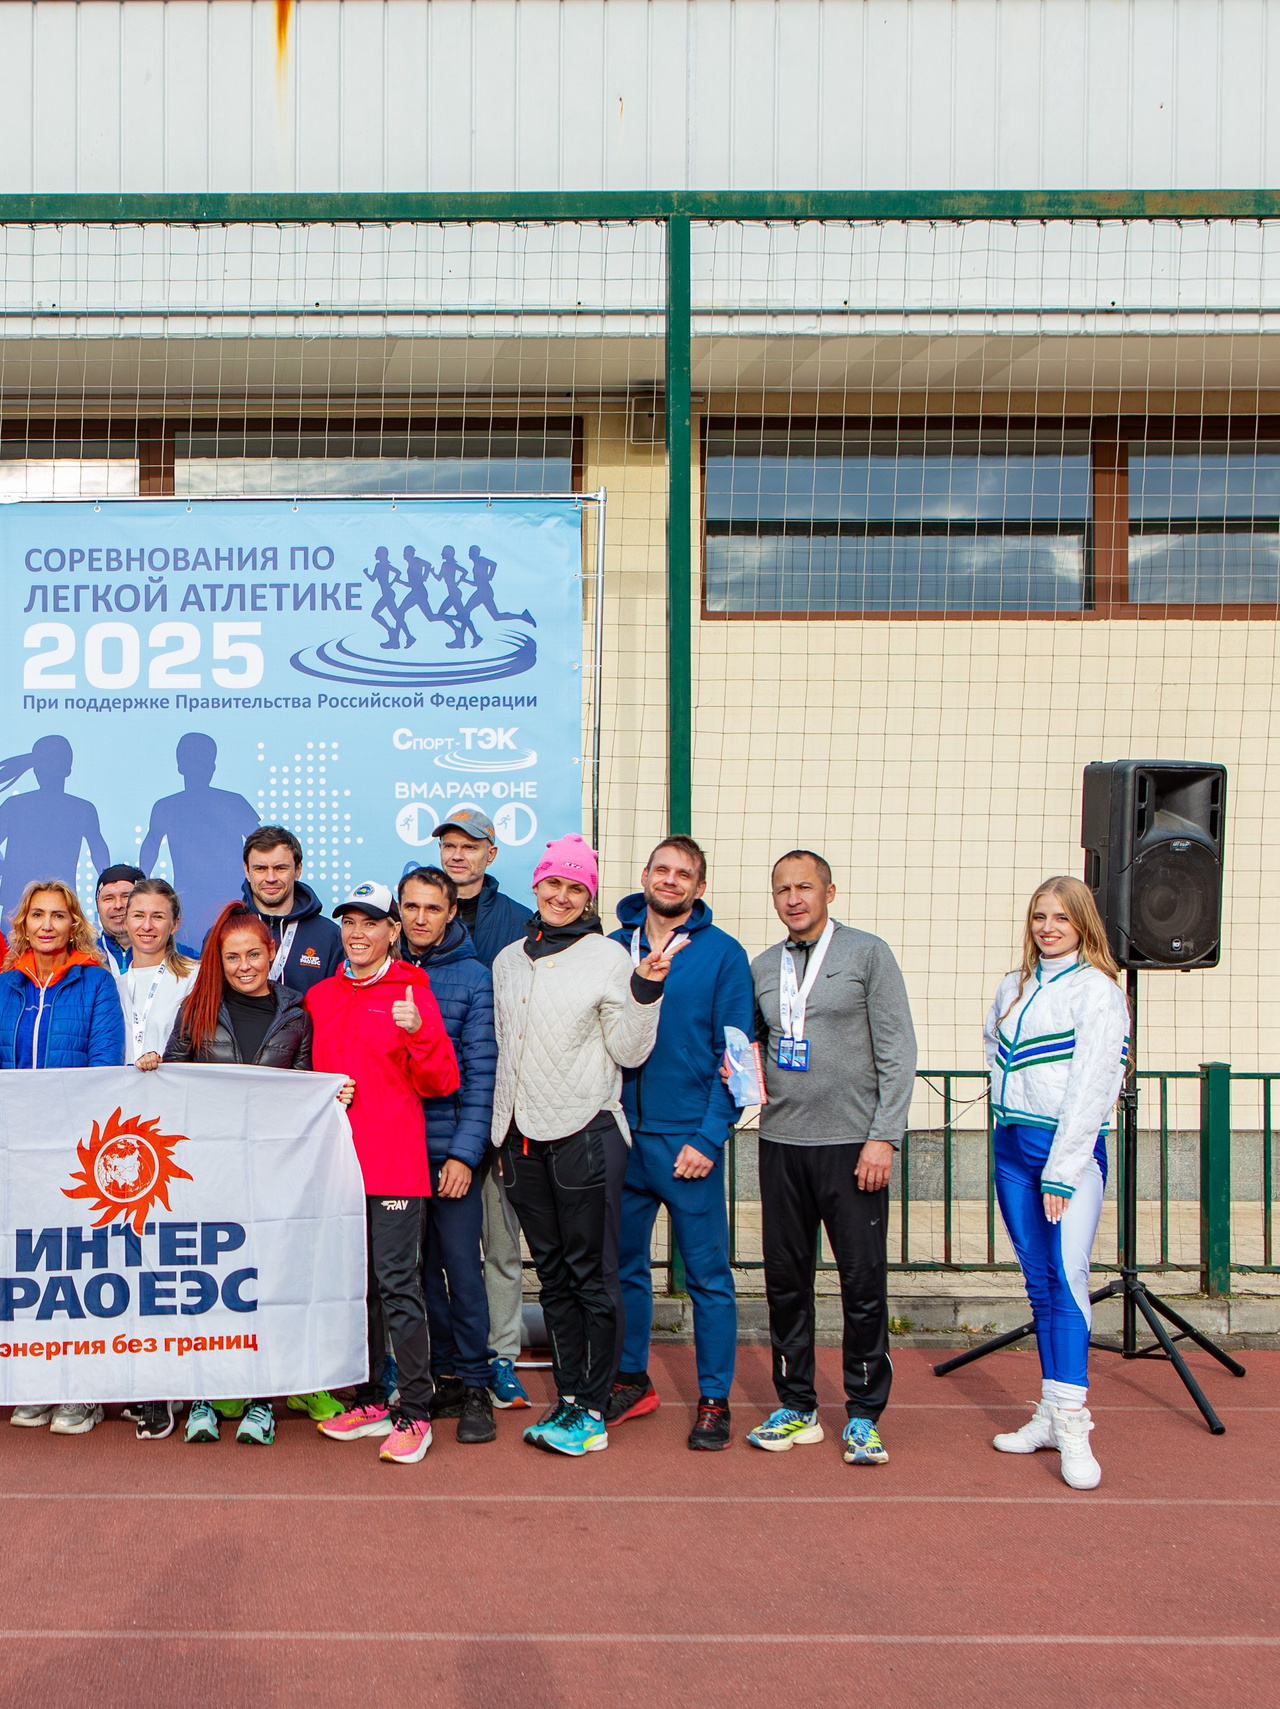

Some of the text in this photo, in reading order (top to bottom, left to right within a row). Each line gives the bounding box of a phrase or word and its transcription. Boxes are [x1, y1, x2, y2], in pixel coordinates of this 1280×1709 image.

[24, 546, 335, 573] СОРЕВНОВАНИЯ ПО
[23, 576, 363, 613] ЛЕГКОЙ АТЛЕТИКЕ
[23, 621, 265, 690] 2025
[23, 691, 538, 713] При поддержке Правительства Российской Федерации
[15, 1221, 247, 1273] ИНТЕР
[138, 1267, 259, 1317] ЕЭС
[111, 1333, 158, 1355] без
[163, 1333, 259, 1357] границ
